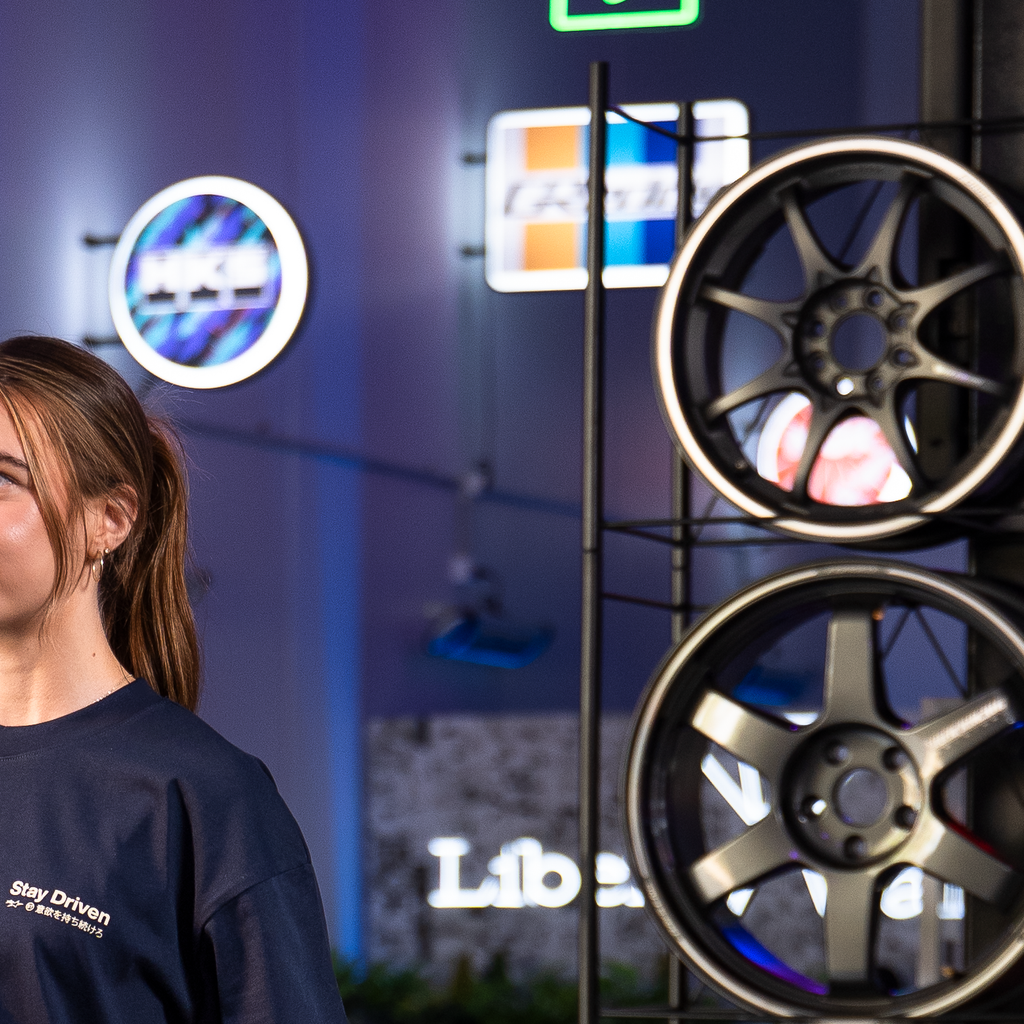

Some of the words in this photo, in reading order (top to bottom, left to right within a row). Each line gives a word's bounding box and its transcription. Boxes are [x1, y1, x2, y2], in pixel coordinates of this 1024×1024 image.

[9, 880, 49, 903] Stay
[49, 889, 111, 927] Driven
[35, 905, 103, 938] 意欲を持ち続けろ
